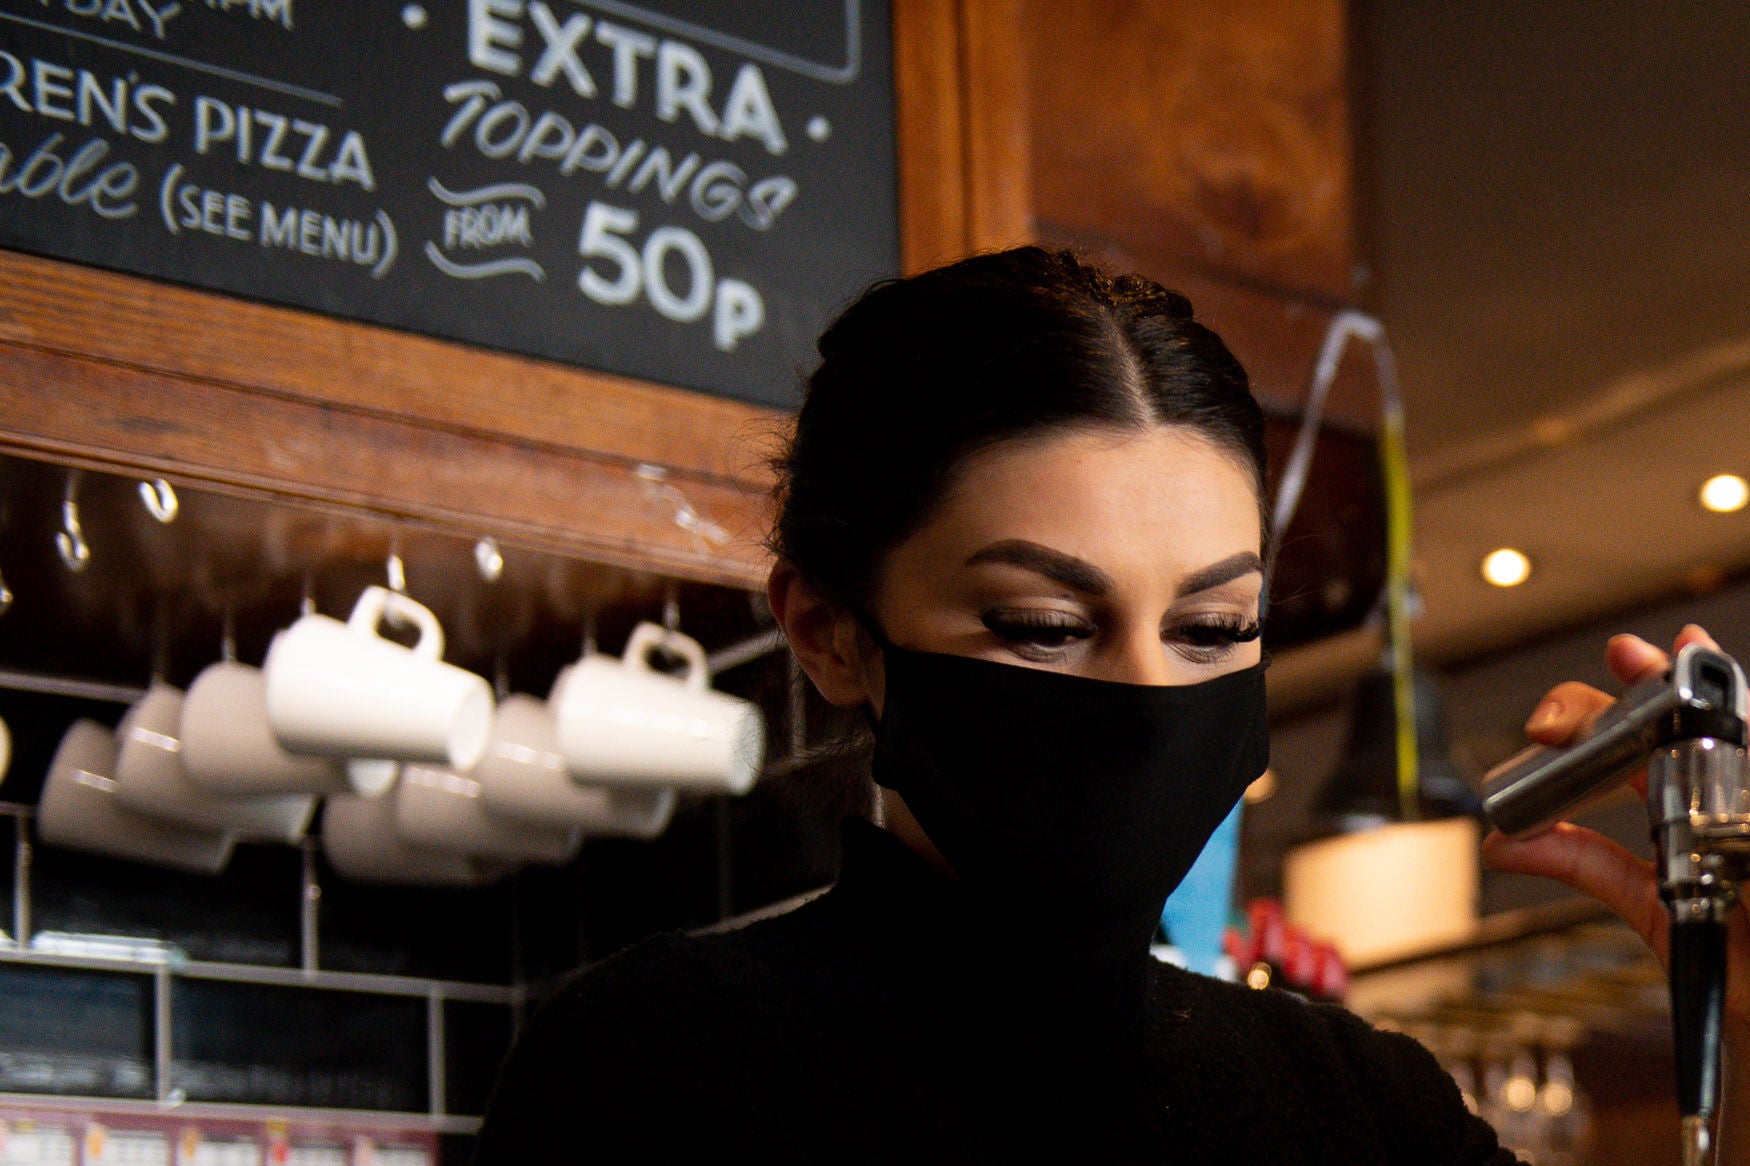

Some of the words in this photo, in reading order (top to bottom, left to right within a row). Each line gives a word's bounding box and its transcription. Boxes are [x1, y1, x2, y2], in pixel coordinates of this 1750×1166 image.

[466, 0, 789, 156] EXTRA
[194, 94, 377, 193] PIZZA
[441, 80, 799, 231] TOPPINGS
[160, 164, 254, 241] (SEE
[259, 202, 400, 280] MENU)
[444, 204, 533, 249] FROM
